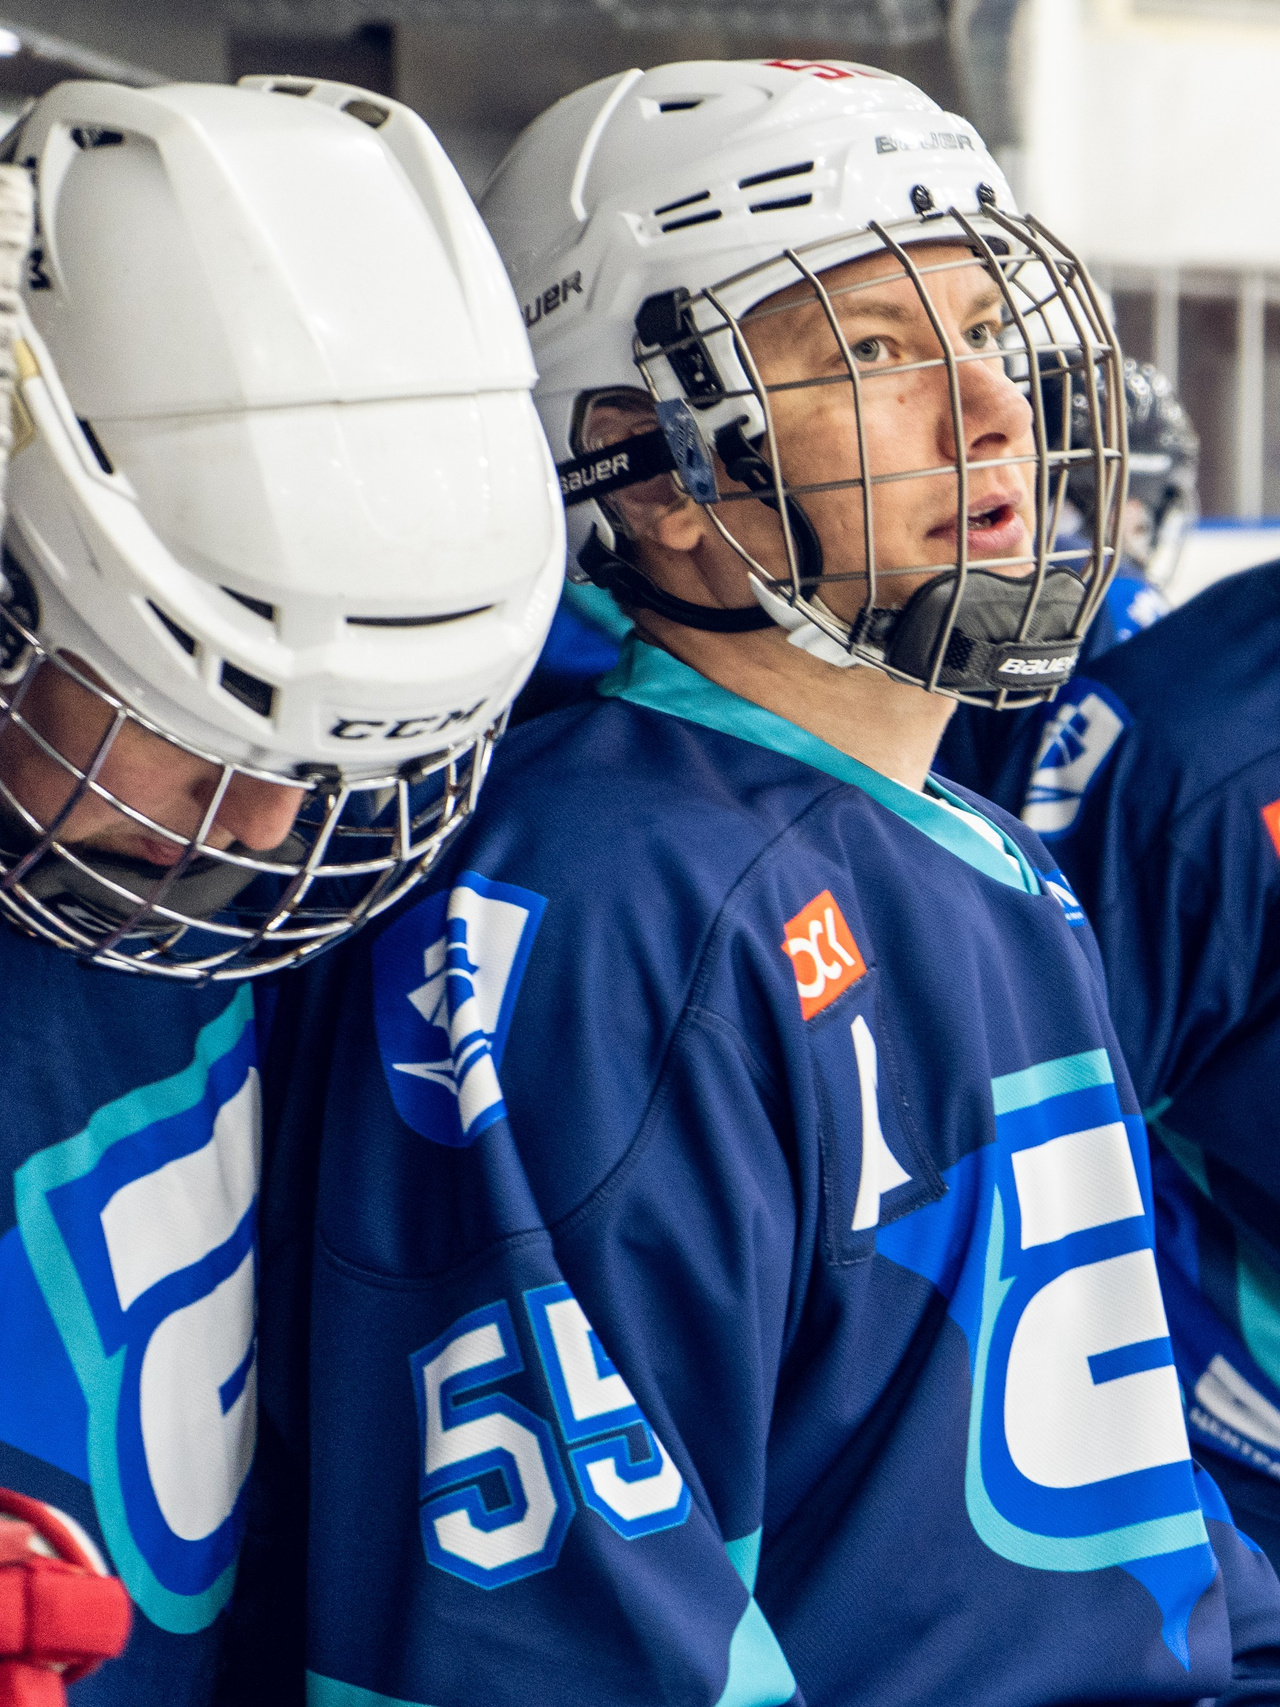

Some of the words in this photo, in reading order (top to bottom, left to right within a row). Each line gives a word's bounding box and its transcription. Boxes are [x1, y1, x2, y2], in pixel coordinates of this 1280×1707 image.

[874, 131, 976, 155] BUER
[521, 270, 583, 329] UER
[329, 697, 488, 740] CCM
[412, 1283, 690, 1588] 55
